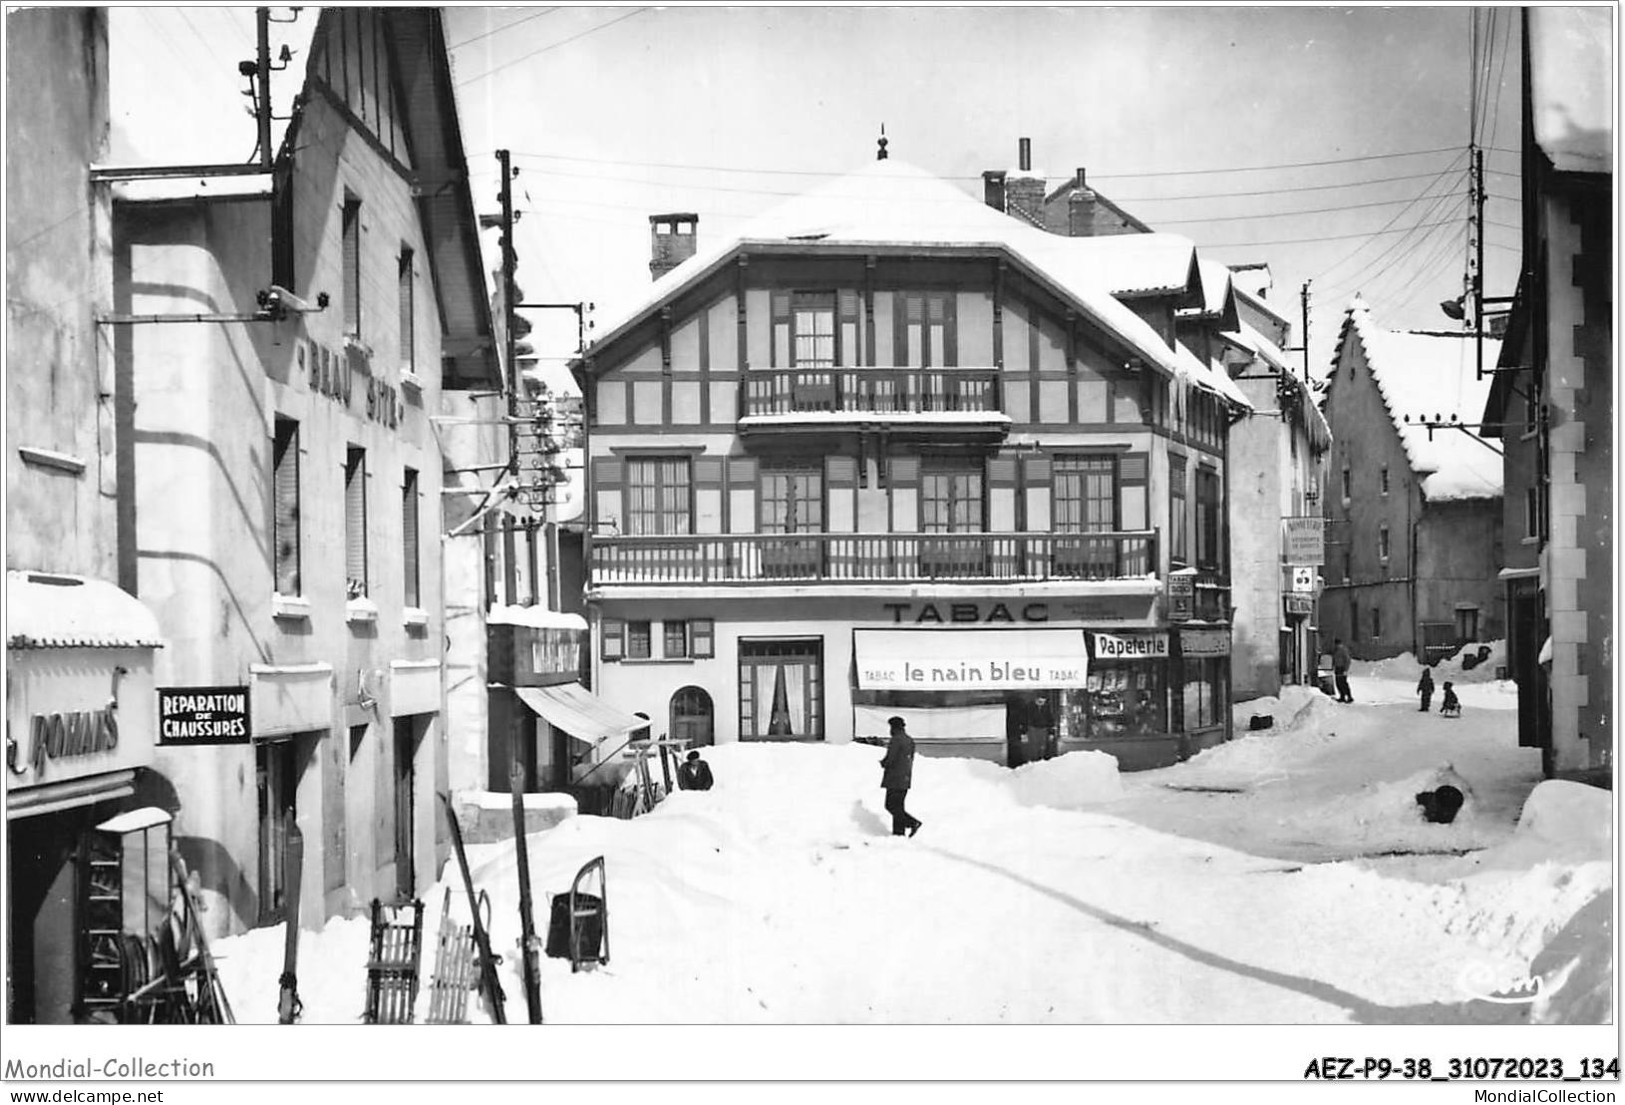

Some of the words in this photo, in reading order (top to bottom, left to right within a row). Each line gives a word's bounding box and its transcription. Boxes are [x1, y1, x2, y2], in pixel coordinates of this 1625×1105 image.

[883, 603, 1049, 624] TABAC
[1100, 635, 1165, 657] Papeterie
[865, 670, 895, 681] TABAC
[905, 661, 925, 682] le
[932, 661, 983, 682] nain
[990, 661, 1041, 682] bleu
[1050, 670, 1079, 681] TABAC
[195, 712, 212, 720] DE
[163, 717, 246, 738] CHAUSSURES
